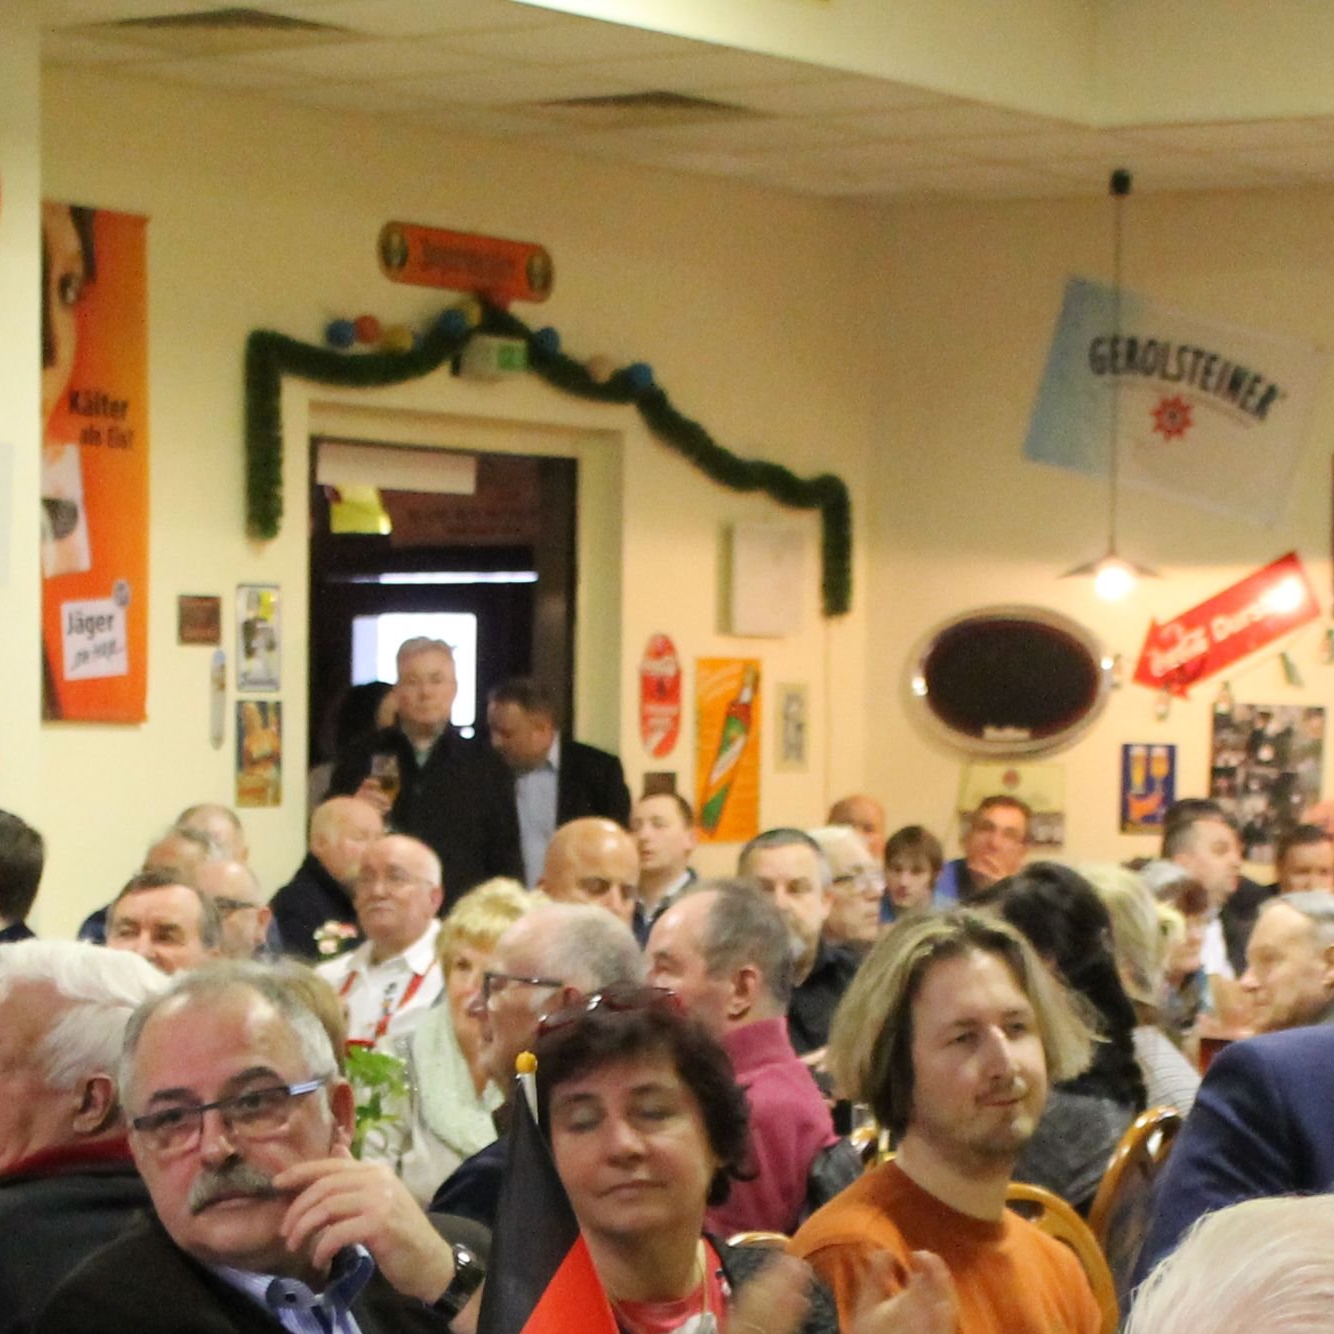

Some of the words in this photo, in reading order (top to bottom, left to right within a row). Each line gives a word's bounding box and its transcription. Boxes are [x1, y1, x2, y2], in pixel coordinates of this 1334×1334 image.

[1088, 334, 1280, 422] GEROLSTEINER
[69, 389, 129, 420] Kälter
[67, 610, 115, 641] Jäger
